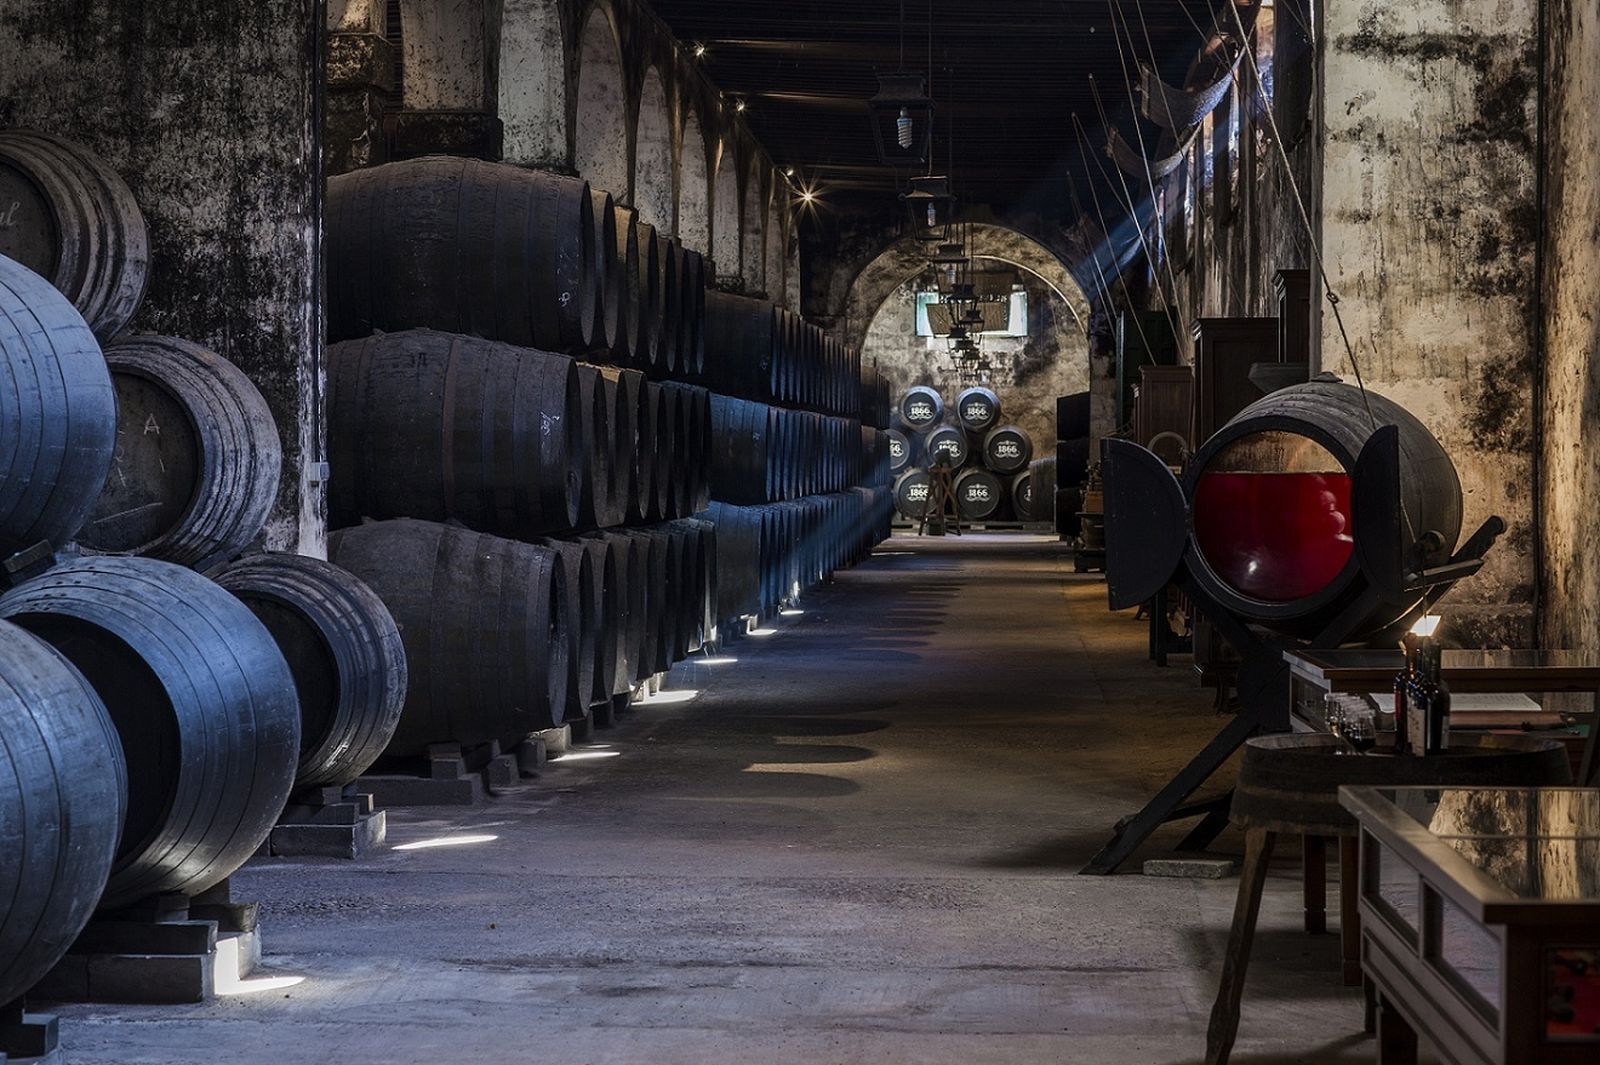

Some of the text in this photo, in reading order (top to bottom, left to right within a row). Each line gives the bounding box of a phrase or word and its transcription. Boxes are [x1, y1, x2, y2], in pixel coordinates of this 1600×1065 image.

[911, 407, 931, 415] 1866
[967, 407, 987, 415] 1866
[144, 412, 161, 434] A
[998, 444, 1018, 452] 1866
[968, 488, 988, 497] 1866
